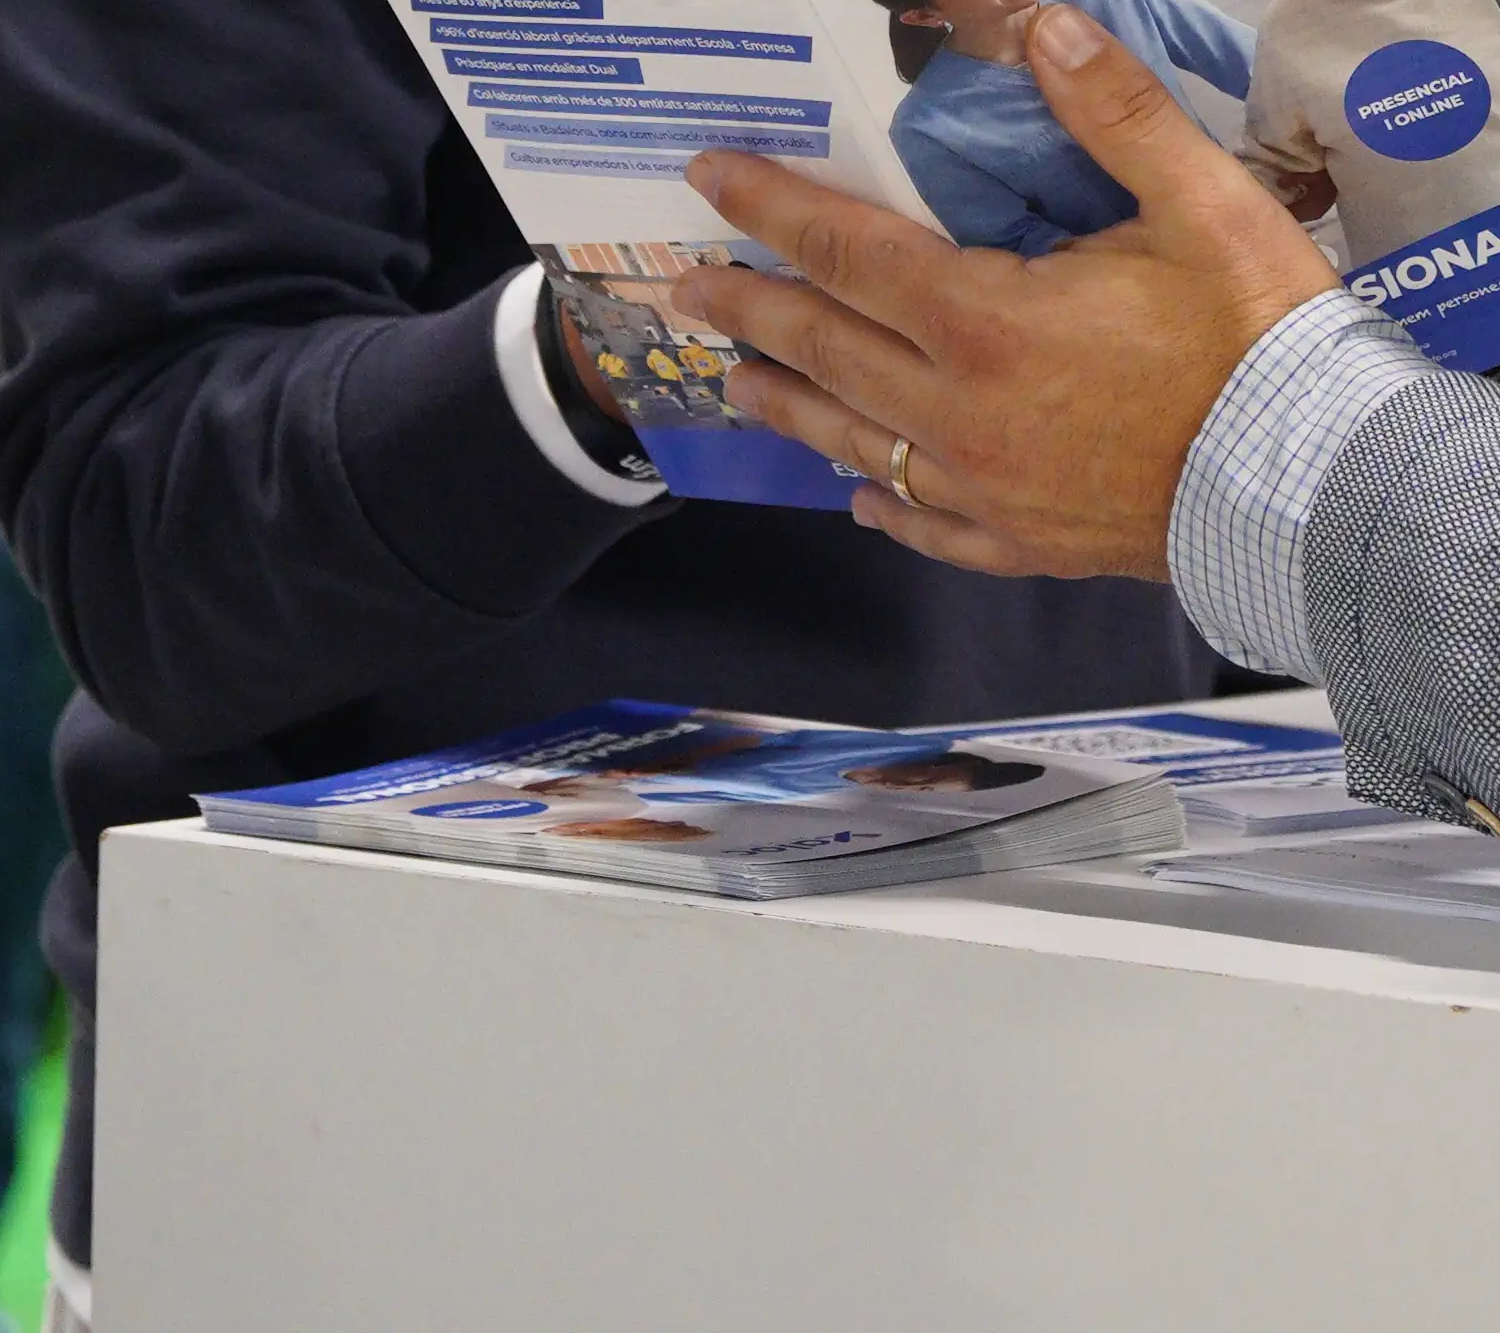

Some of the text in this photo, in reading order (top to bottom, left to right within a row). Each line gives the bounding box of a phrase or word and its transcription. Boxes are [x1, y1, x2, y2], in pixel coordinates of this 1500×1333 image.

[477, 0, 503, 10] anys
[521, 31, 562, 42] laboral
[606, 34, 616, 44] al
[619, 35, 694, 48] departament
[697, 38, 734, 49] Escola
[743, 40, 795, 54] Empresa
[518, 63, 532, 71] en
[533, 63, 589, 74] modalitat
[589, 64, 618, 75] Dual
[544, 94, 569, 104] amb
[570, 95, 596, 106] més
[597, 97, 611, 106] de
[612, 97, 638, 107] 300
[640, 99, 683, 110] entitats
[749, 106, 805, 117] empreses
[1358, 71, 1473, 119] PRESENCIAL
[1384, 94, 1464, 130] I ONLINE
[597, 128, 628, 139] bona
[629, 130, 702, 142] comunicació
[706, 134, 723, 143] en
[724, 135, 777, 147] transport
[779, 137, 814, 149] públic
[510, 152, 550, 165] Cultura
[552, 158, 628, 170] emprenedora
[638, 161, 653, 171] de
